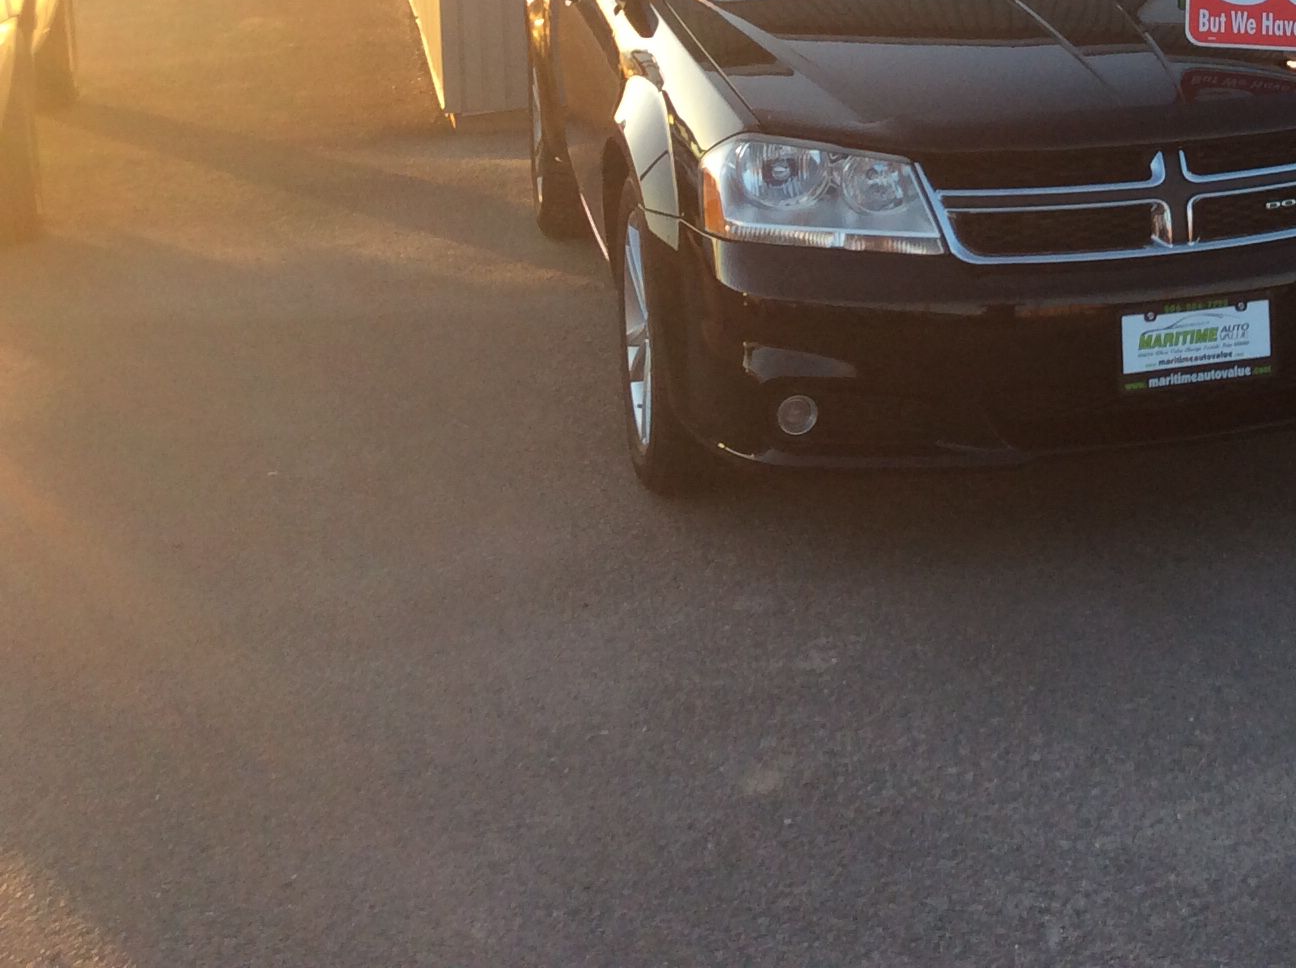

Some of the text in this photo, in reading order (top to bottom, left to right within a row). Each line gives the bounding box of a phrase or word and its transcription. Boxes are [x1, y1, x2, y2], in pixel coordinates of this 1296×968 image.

[1198, 8, 1226, 34] But
[1231, 10, 1256, 36] We
[1138, 326, 1219, 351] MARITIME
[1220, 322, 1250, 333] AUTO
